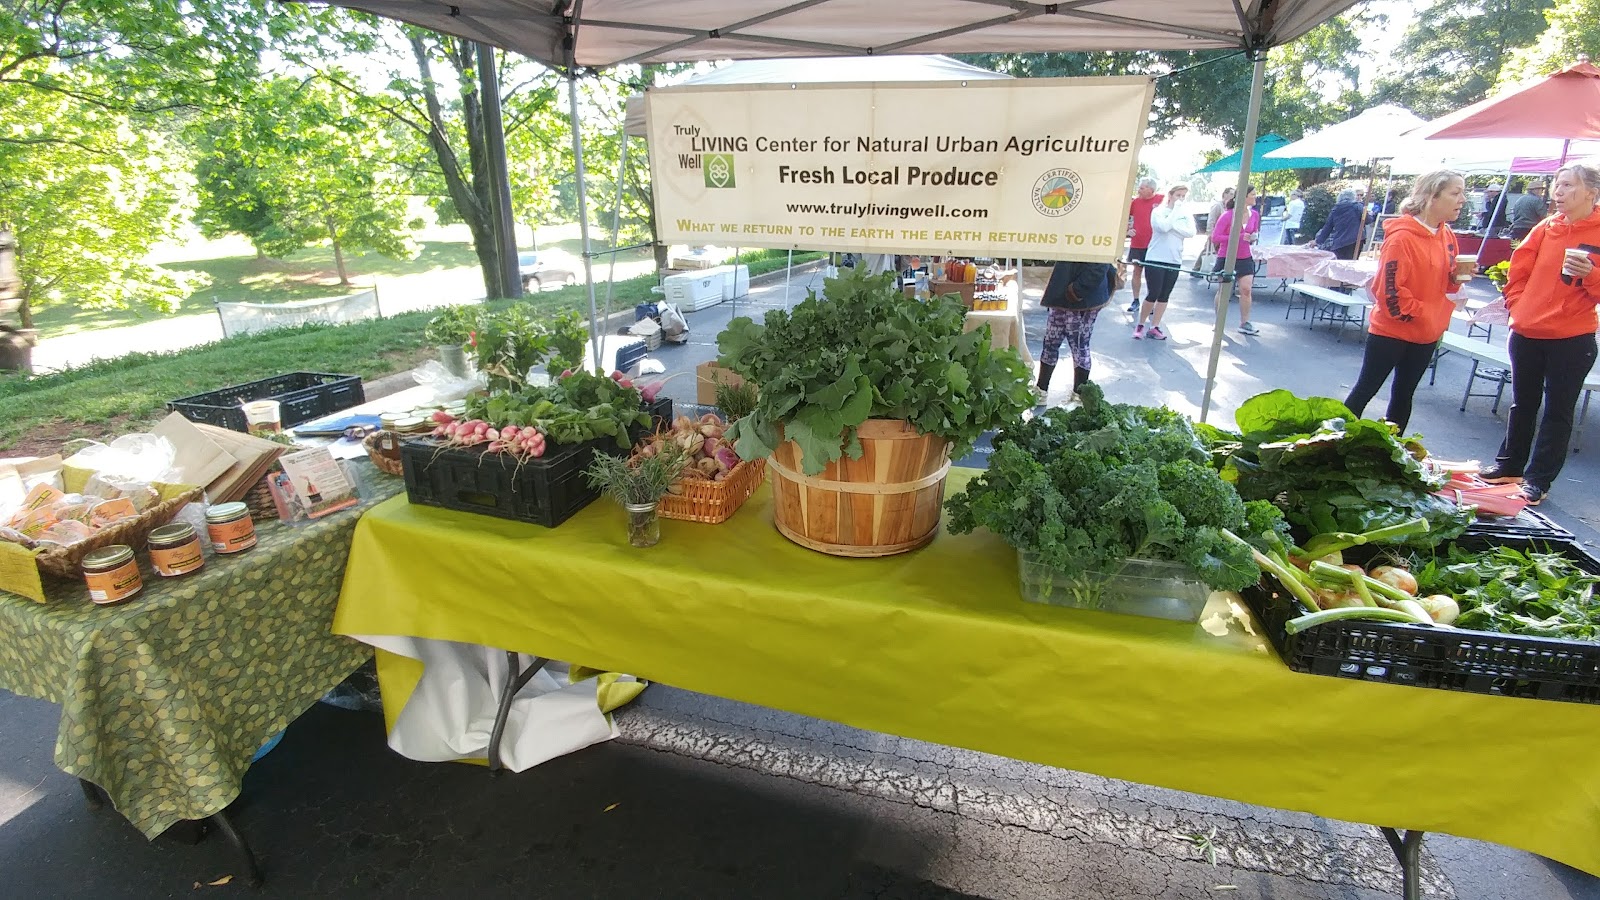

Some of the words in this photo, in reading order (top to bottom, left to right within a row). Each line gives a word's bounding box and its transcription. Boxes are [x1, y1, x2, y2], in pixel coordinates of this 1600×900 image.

[674, 126, 700, 137] Truly
[692, 137, 748, 152] LIVING
[755, 137, 817, 152] Center
[823, 136, 850, 152] for
[857, 136, 929, 152] Natural
[936, 136, 998, 153] Urban
[1004, 135, 1129, 156] Agriculture
[678, 154, 701, 169] Well
[779, 166, 835, 184] Fresh
[843, 166, 898, 185] Local
[907, 166, 998, 186] Produce
[1042, 169, 1079, 184] CERTIFIED
[1034, 187, 1060, 215] NATURALLY
[1064, 188, 1081, 211] GROWN
[786, 202, 988, 219] www.trulylivingwell.com
[720, 223, 738, 232] WE
[743, 224, 793, 235] RETURN
[798, 226, 815, 236] TO
[820, 226, 845, 237] THE
[851, 228, 894, 239] EARTH
[900, 230, 928, 240] THE
[934, 230, 982, 242] EARTH
[988, 231, 1058, 244] RETURNS
[1065, 234, 1086, 246] TO
[1091, 235, 1112, 247] US
